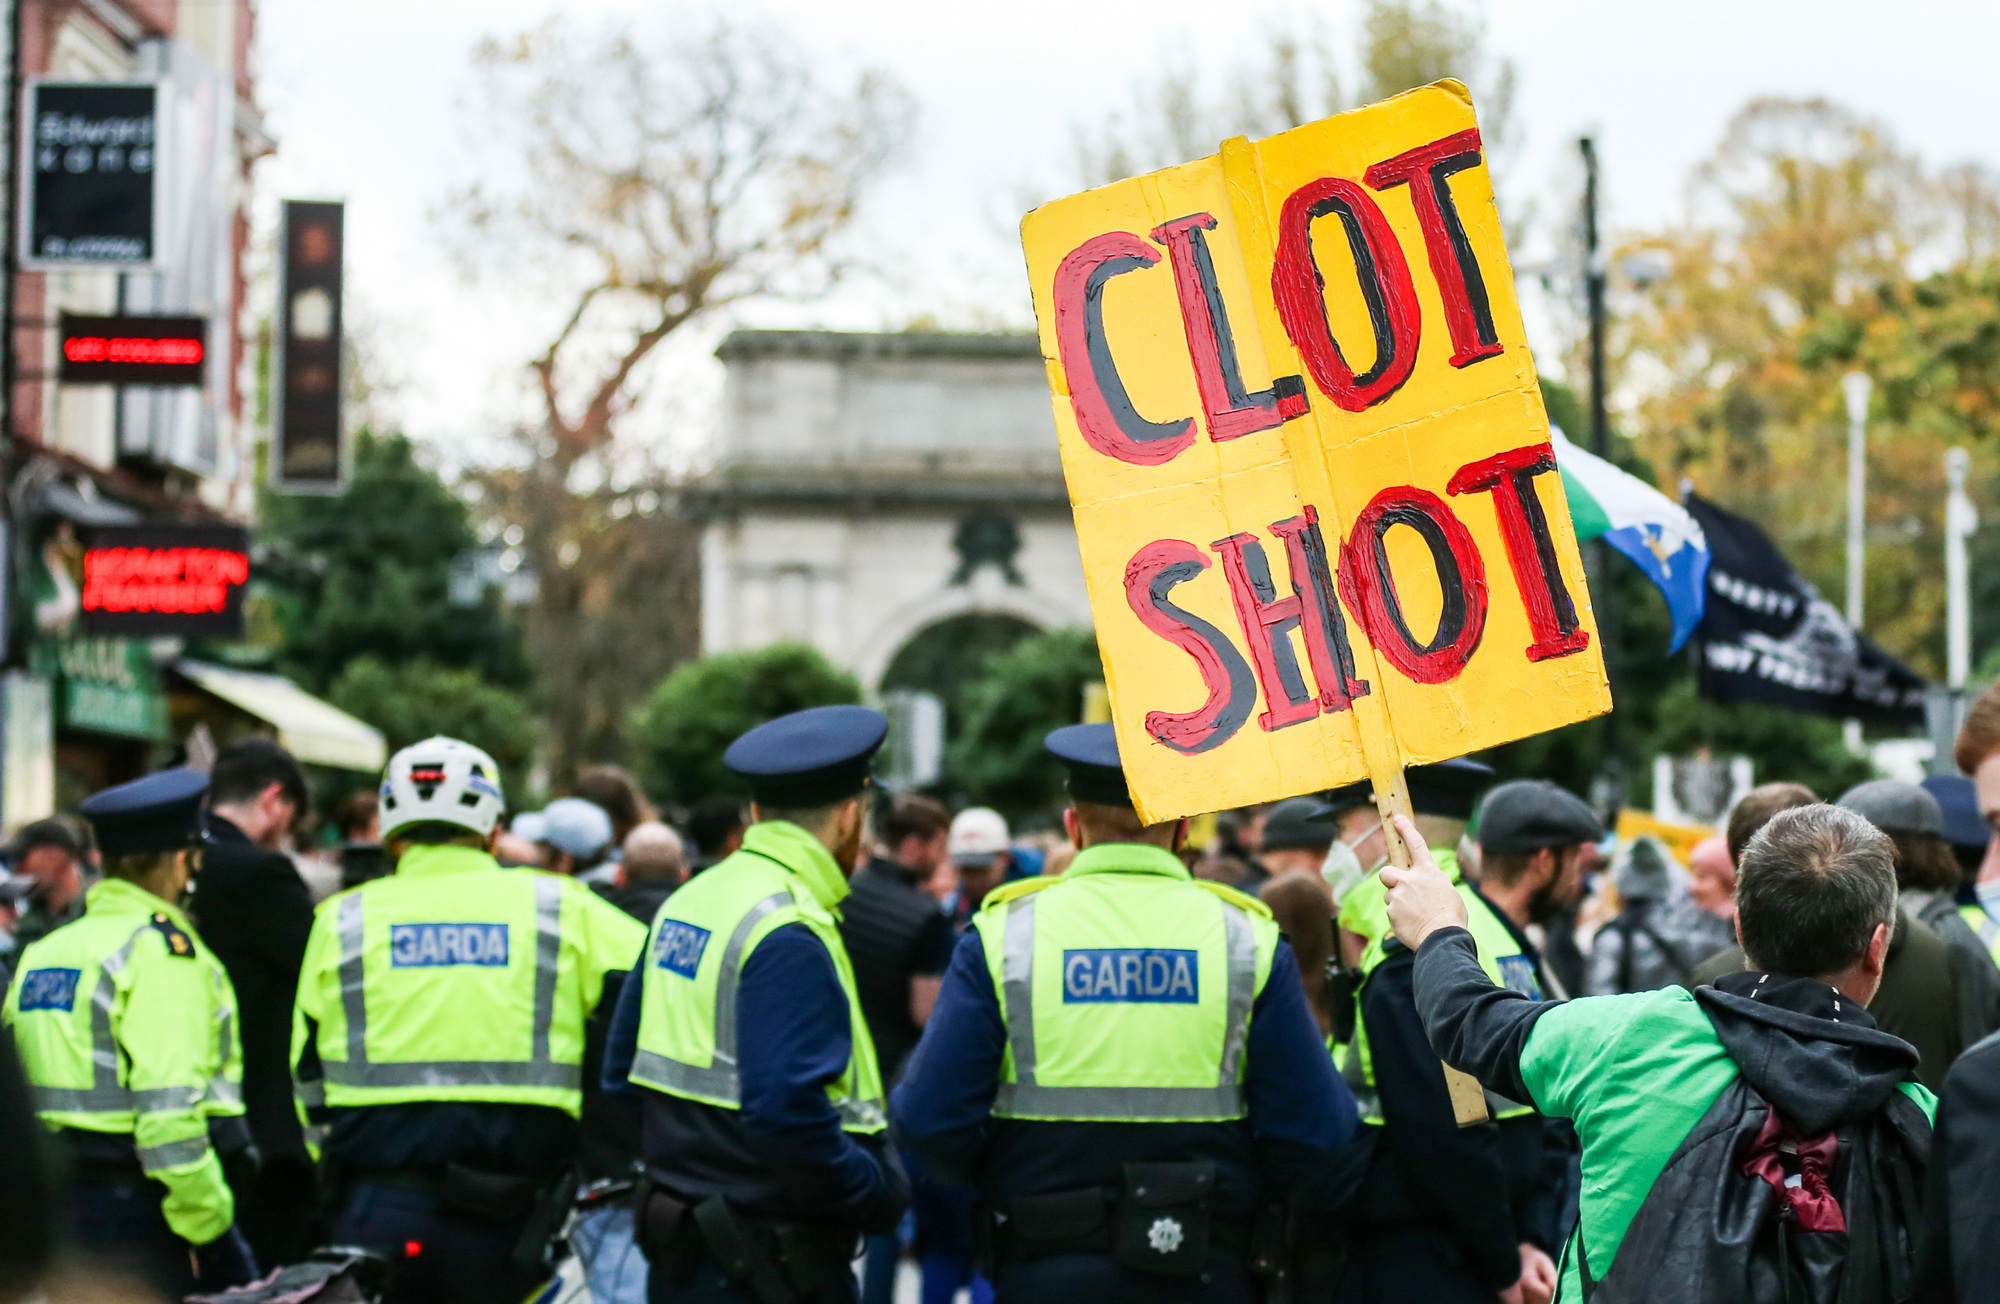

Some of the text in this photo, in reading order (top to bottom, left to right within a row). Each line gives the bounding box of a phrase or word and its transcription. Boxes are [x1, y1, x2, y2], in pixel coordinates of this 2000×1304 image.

[1053, 128, 1504, 466] CLOT
[1124, 443, 1590, 756] SHOT
[394, 927, 507, 963] GARDA
[1065, 955, 1195, 997] GARDA
